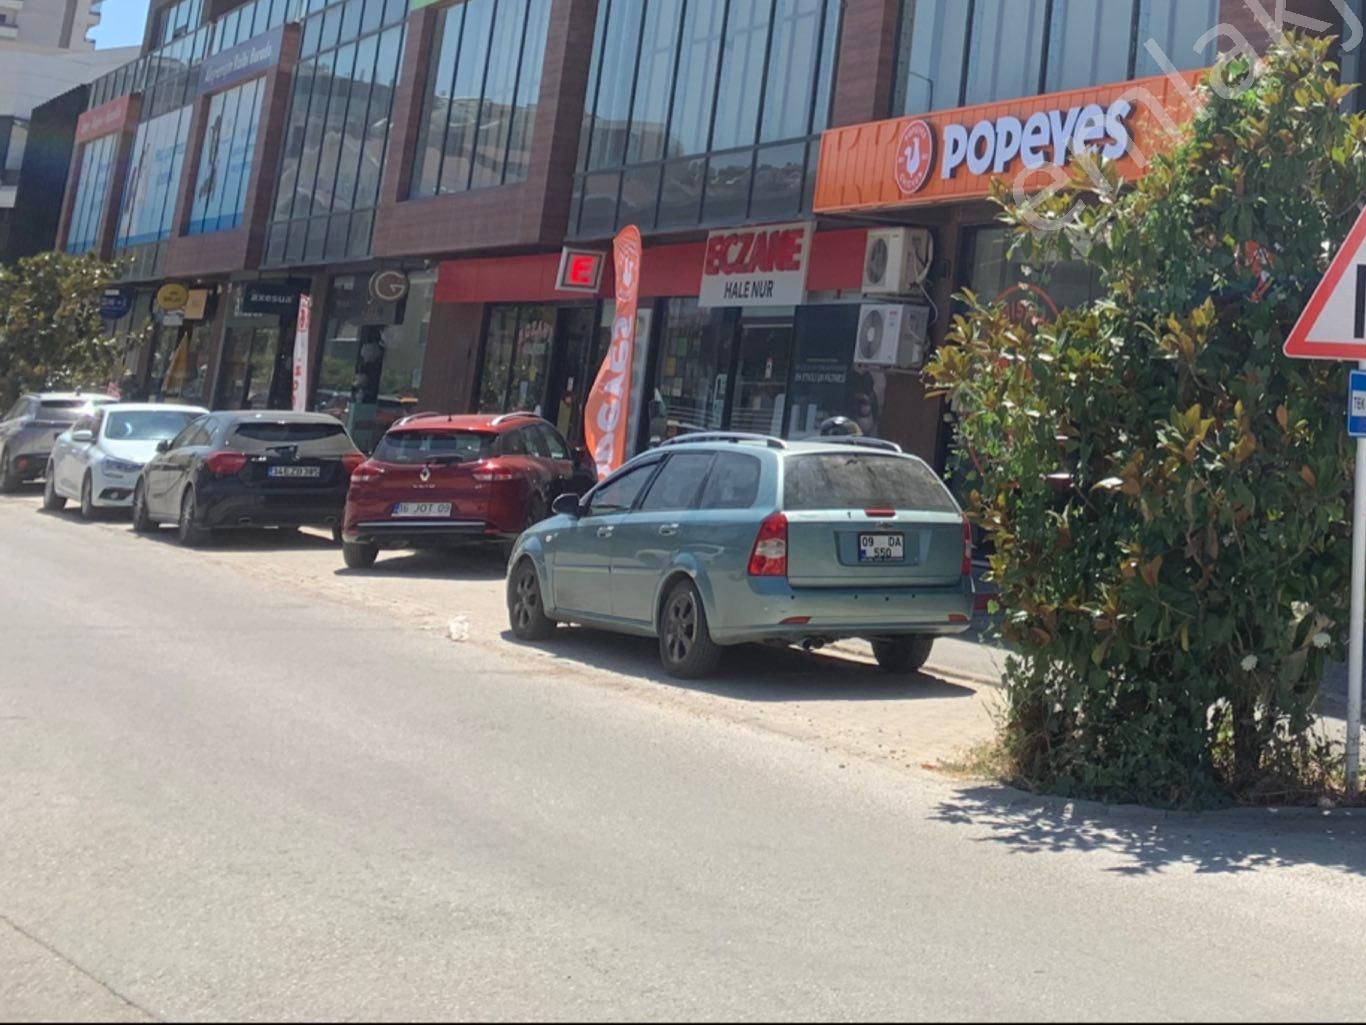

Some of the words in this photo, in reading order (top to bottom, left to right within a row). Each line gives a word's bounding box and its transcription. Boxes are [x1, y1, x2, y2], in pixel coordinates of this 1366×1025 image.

[703, 228, 804, 276] ECZANE
[569, 255, 595, 285] E
[723, 281, 751, 299] HALE
[750, 279, 775, 298] NUR
[1353, 396, 1366, 410] TEK
[862, 536, 875, 547] 09
[888, 536, 902, 547] DA
[873, 548, 892, 559] 550
